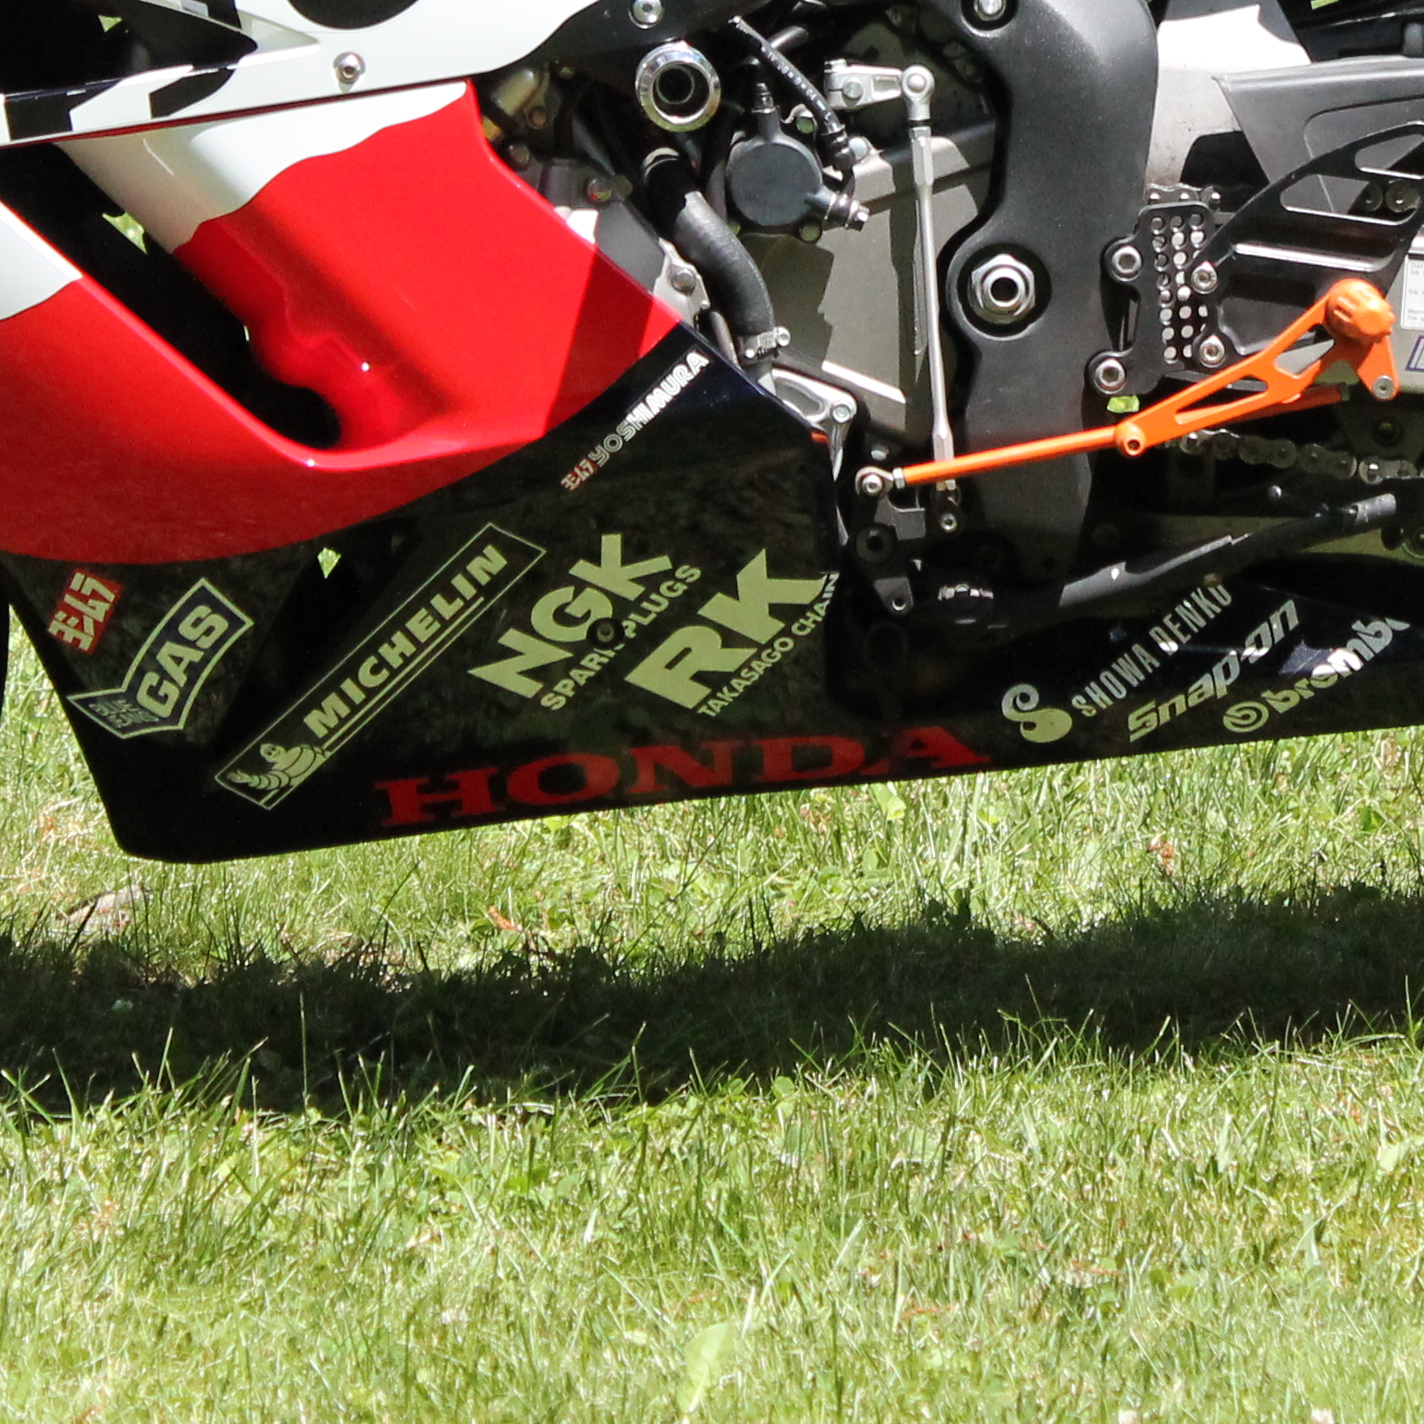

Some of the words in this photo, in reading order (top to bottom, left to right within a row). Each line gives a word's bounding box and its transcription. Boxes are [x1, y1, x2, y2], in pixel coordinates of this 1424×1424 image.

[587, 349, 711, 468] YOSHIMURA
[302, 543, 508, 739] MICHELIN
[466, 532, 673, 699] NGK
[621, 563, 703, 639] PLUGS
[624, 547, 827, 710] RK
[697, 636, 795, 718] TAKASAGO
[789, 571, 840, 638] CHAIN
[135, 604, 230, 719] GAS
[1070, 642, 1161, 719] SHOWA
[376, 725, 991, 828] HONDA
